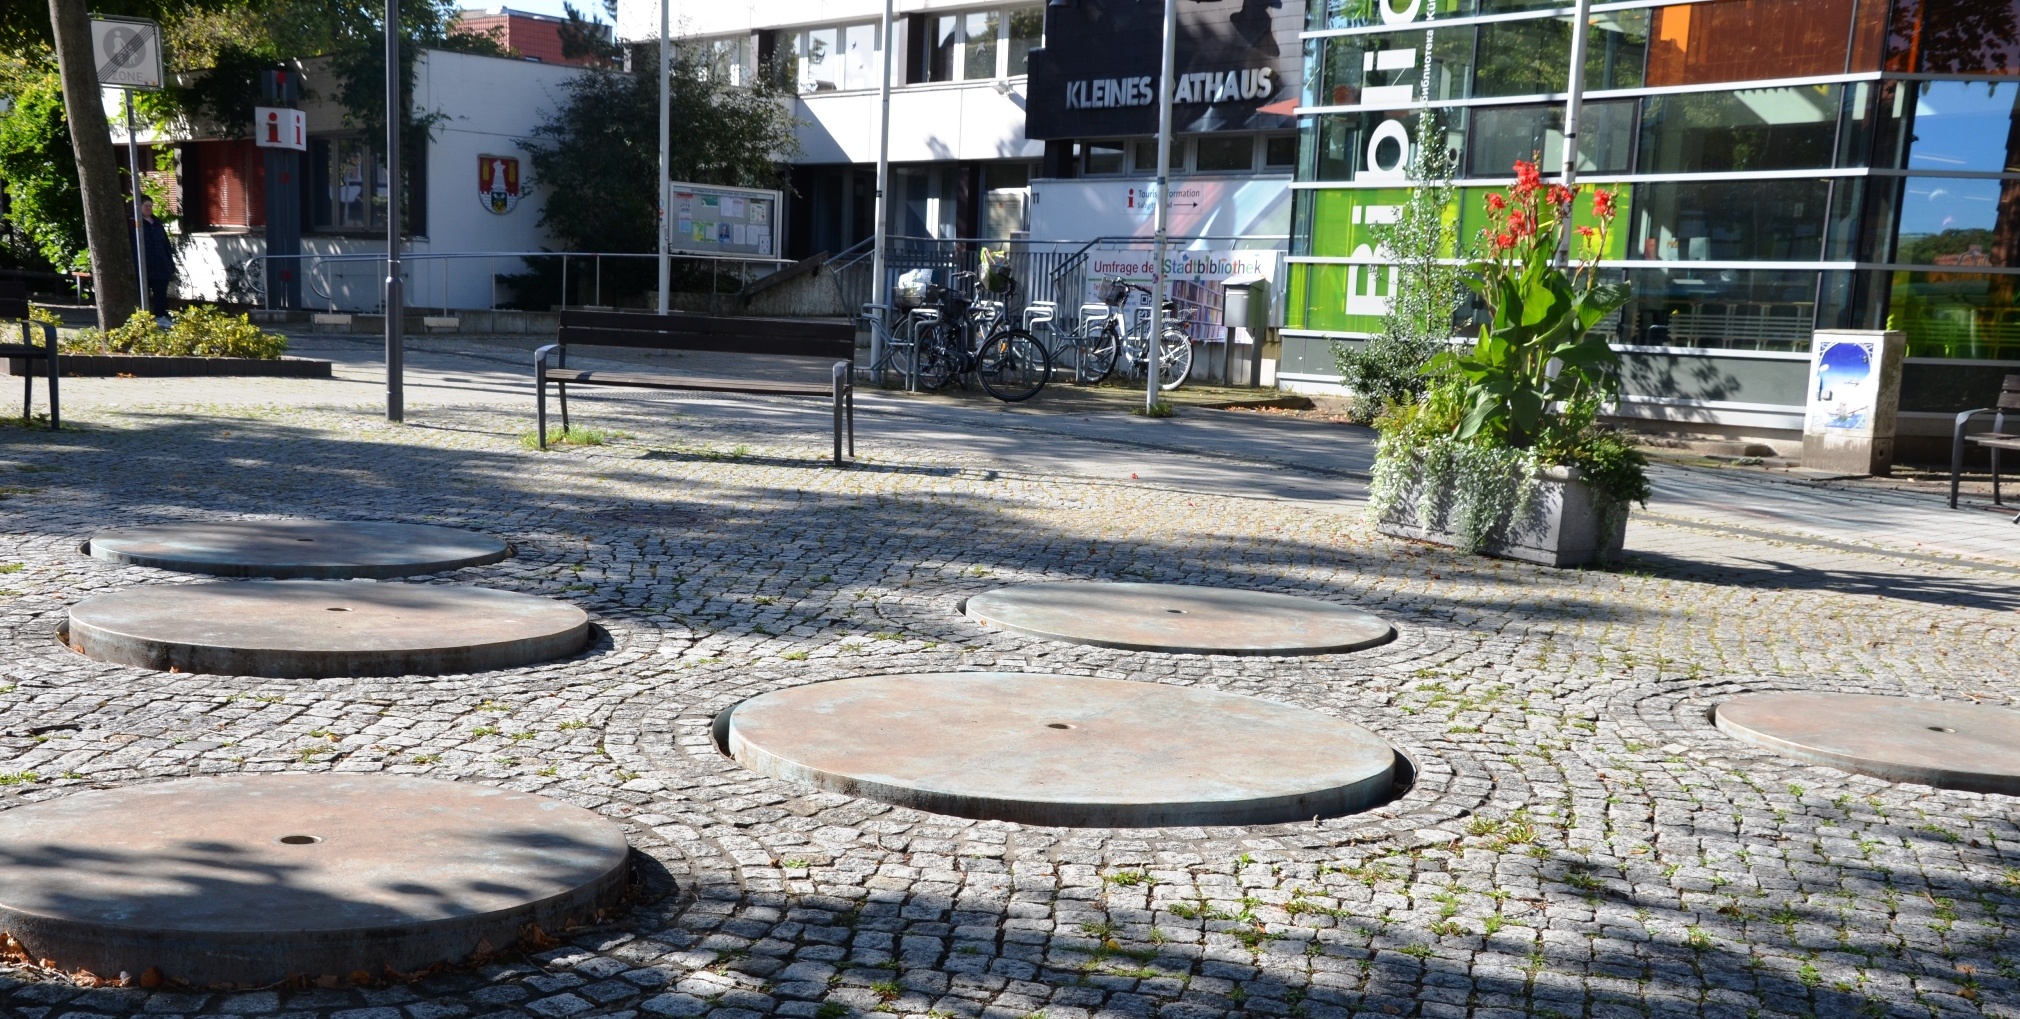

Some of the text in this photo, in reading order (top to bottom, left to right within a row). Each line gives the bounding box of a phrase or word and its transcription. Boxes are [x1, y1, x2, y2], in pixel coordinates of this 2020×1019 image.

[111, 70, 144, 82] ZONE
[1066, 76, 1153, 109] KLEINES
[1031, 192, 1040, 205] 11
[1094, 257, 1262, 276] Umfrage de Stadtbibliothek
